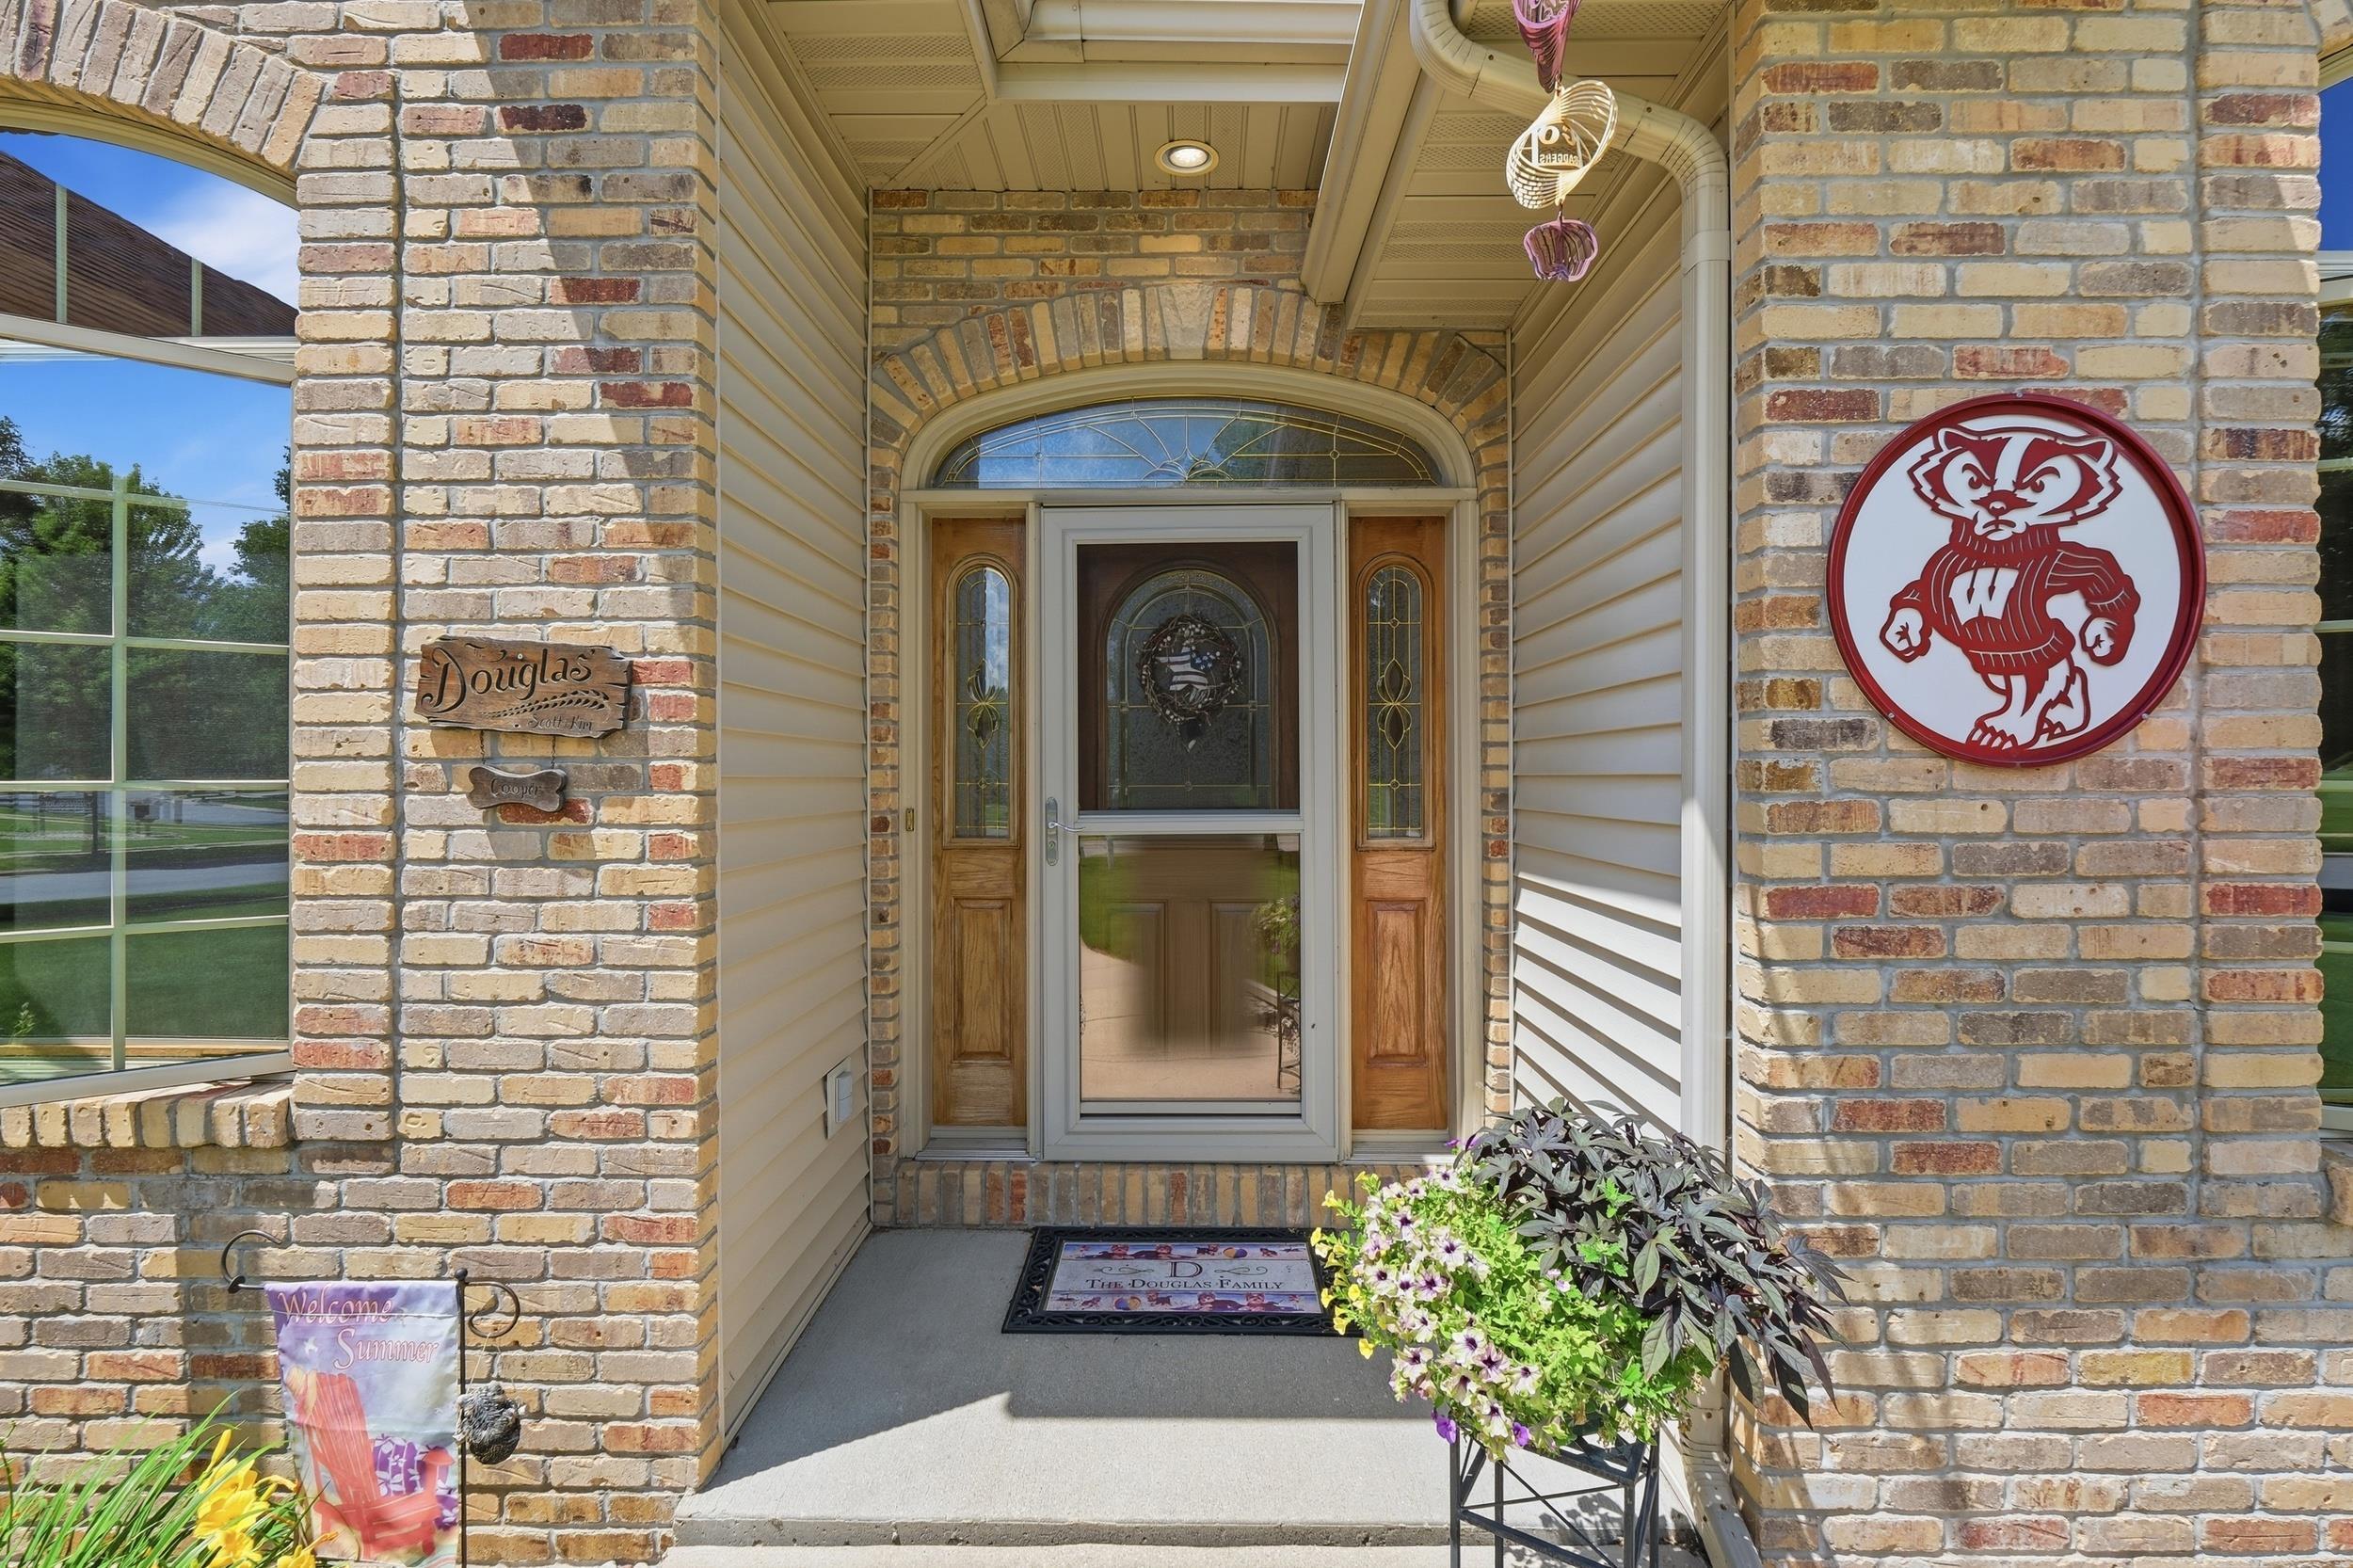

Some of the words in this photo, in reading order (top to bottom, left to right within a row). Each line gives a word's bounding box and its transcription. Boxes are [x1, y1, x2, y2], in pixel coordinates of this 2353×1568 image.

[1948, 568, 2020, 626] W
[528, 713, 562, 728] Scott
[568, 715, 593, 730] Kim
[490, 777, 541, 799] Cooper
[1166, 1261, 1204, 1278] D
[278, 1284, 394, 1325] Welcome
[333, 1327, 440, 1370] Summer
